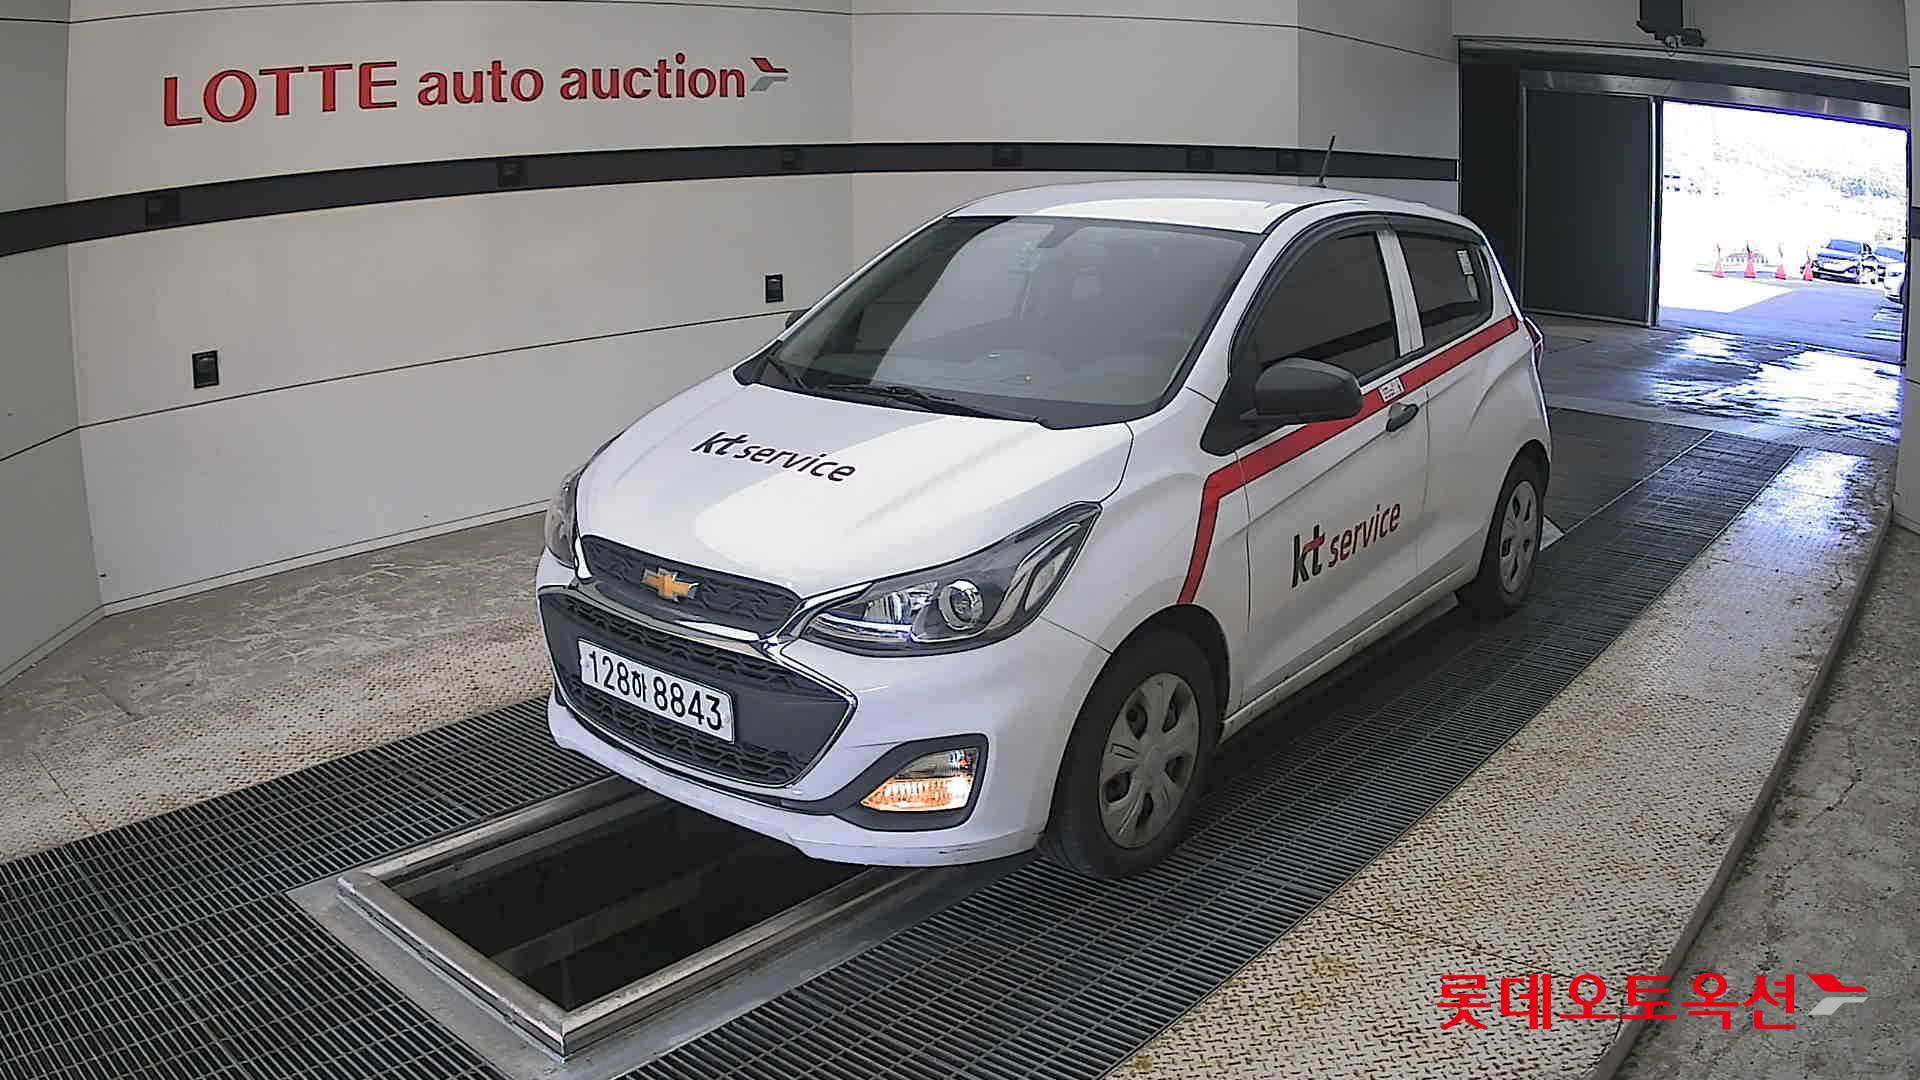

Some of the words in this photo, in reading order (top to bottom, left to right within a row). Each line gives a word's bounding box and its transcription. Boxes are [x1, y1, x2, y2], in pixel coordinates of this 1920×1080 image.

[164, 61, 397, 126] LOTTE
[417, 60, 544, 105] auto
[560, 52, 745, 99] auction
[691, 432, 748, 455] kt
[734, 445, 856, 482] service
[1292, 524, 1325, 588] kt
[1328, 503, 1400, 567] service
[589, 651, 647, 703] 128하
[653, 676, 722, 731] 8843
